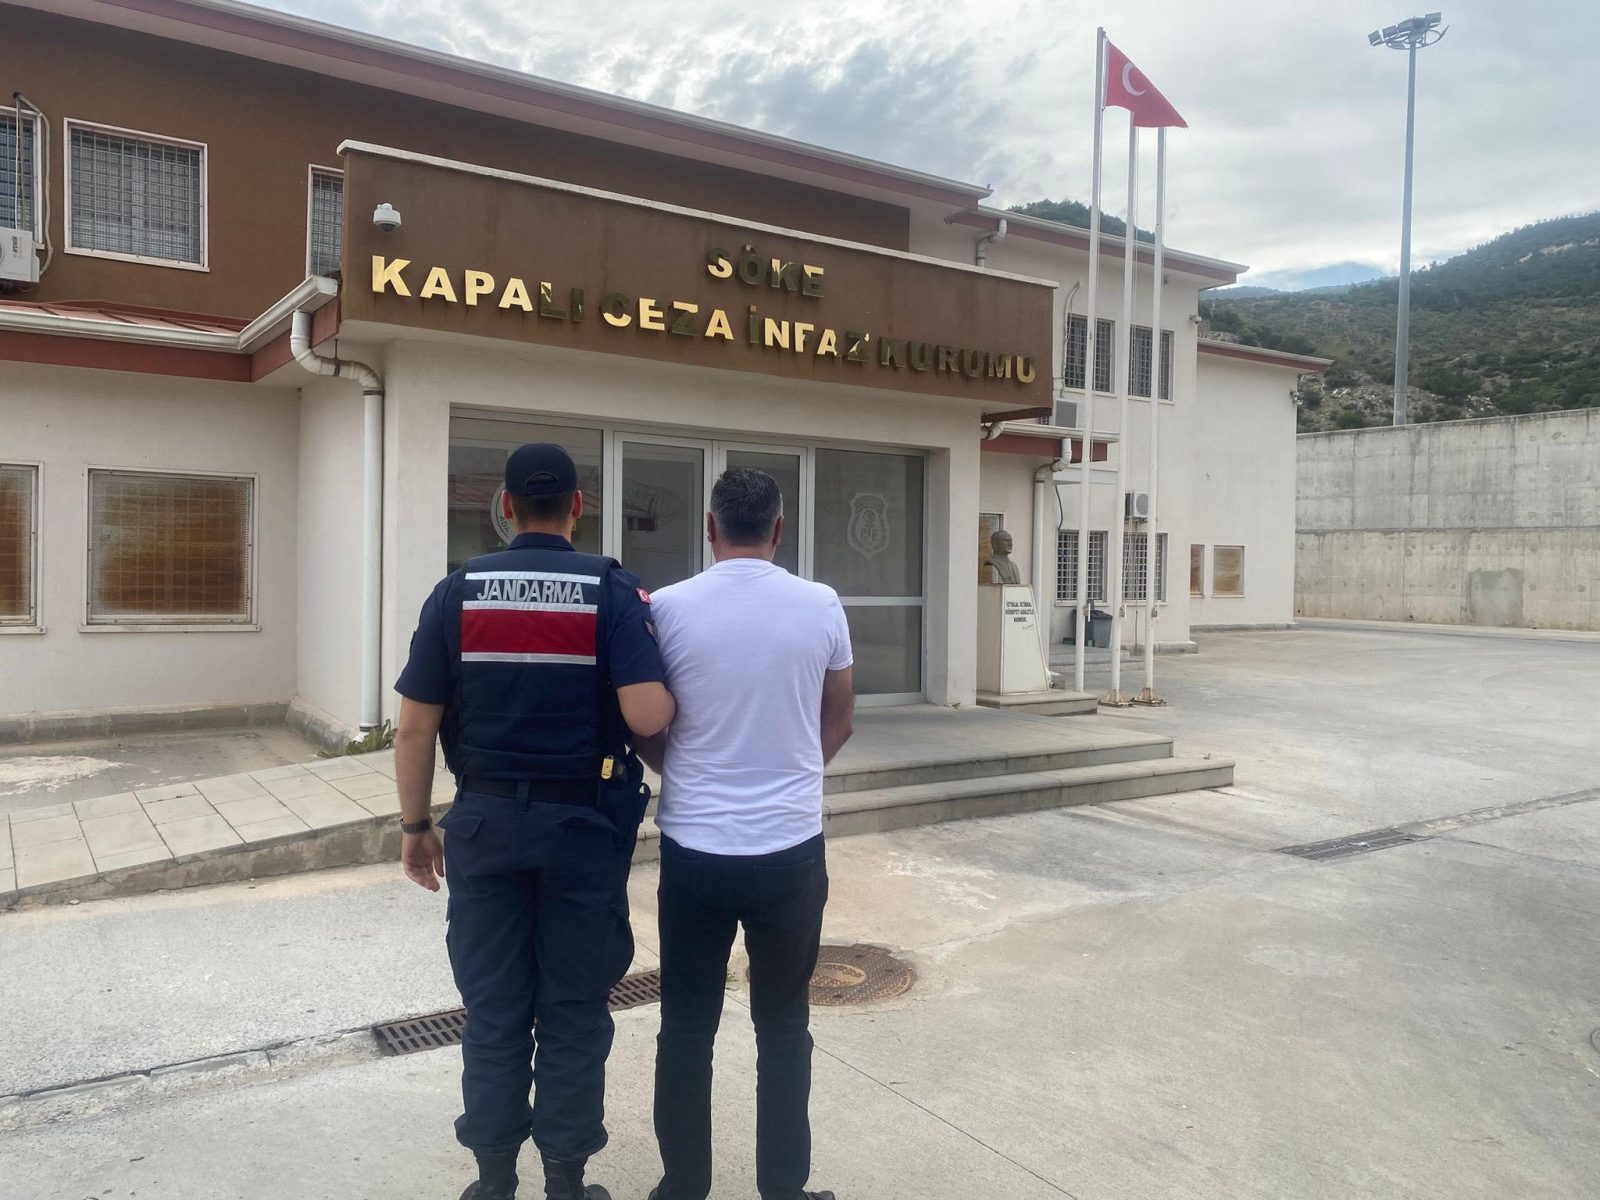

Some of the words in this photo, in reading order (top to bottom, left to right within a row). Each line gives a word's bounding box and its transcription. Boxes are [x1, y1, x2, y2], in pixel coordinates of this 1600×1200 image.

[707, 244, 825, 298] SÖKE
[372, 255, 585, 322] KAPALI
[602, 292, 734, 341] CEZA
[746, 305, 872, 363] İNFAZ
[878, 337, 1036, 384] KURUMU
[476, 579, 585, 604] JANDARMA
